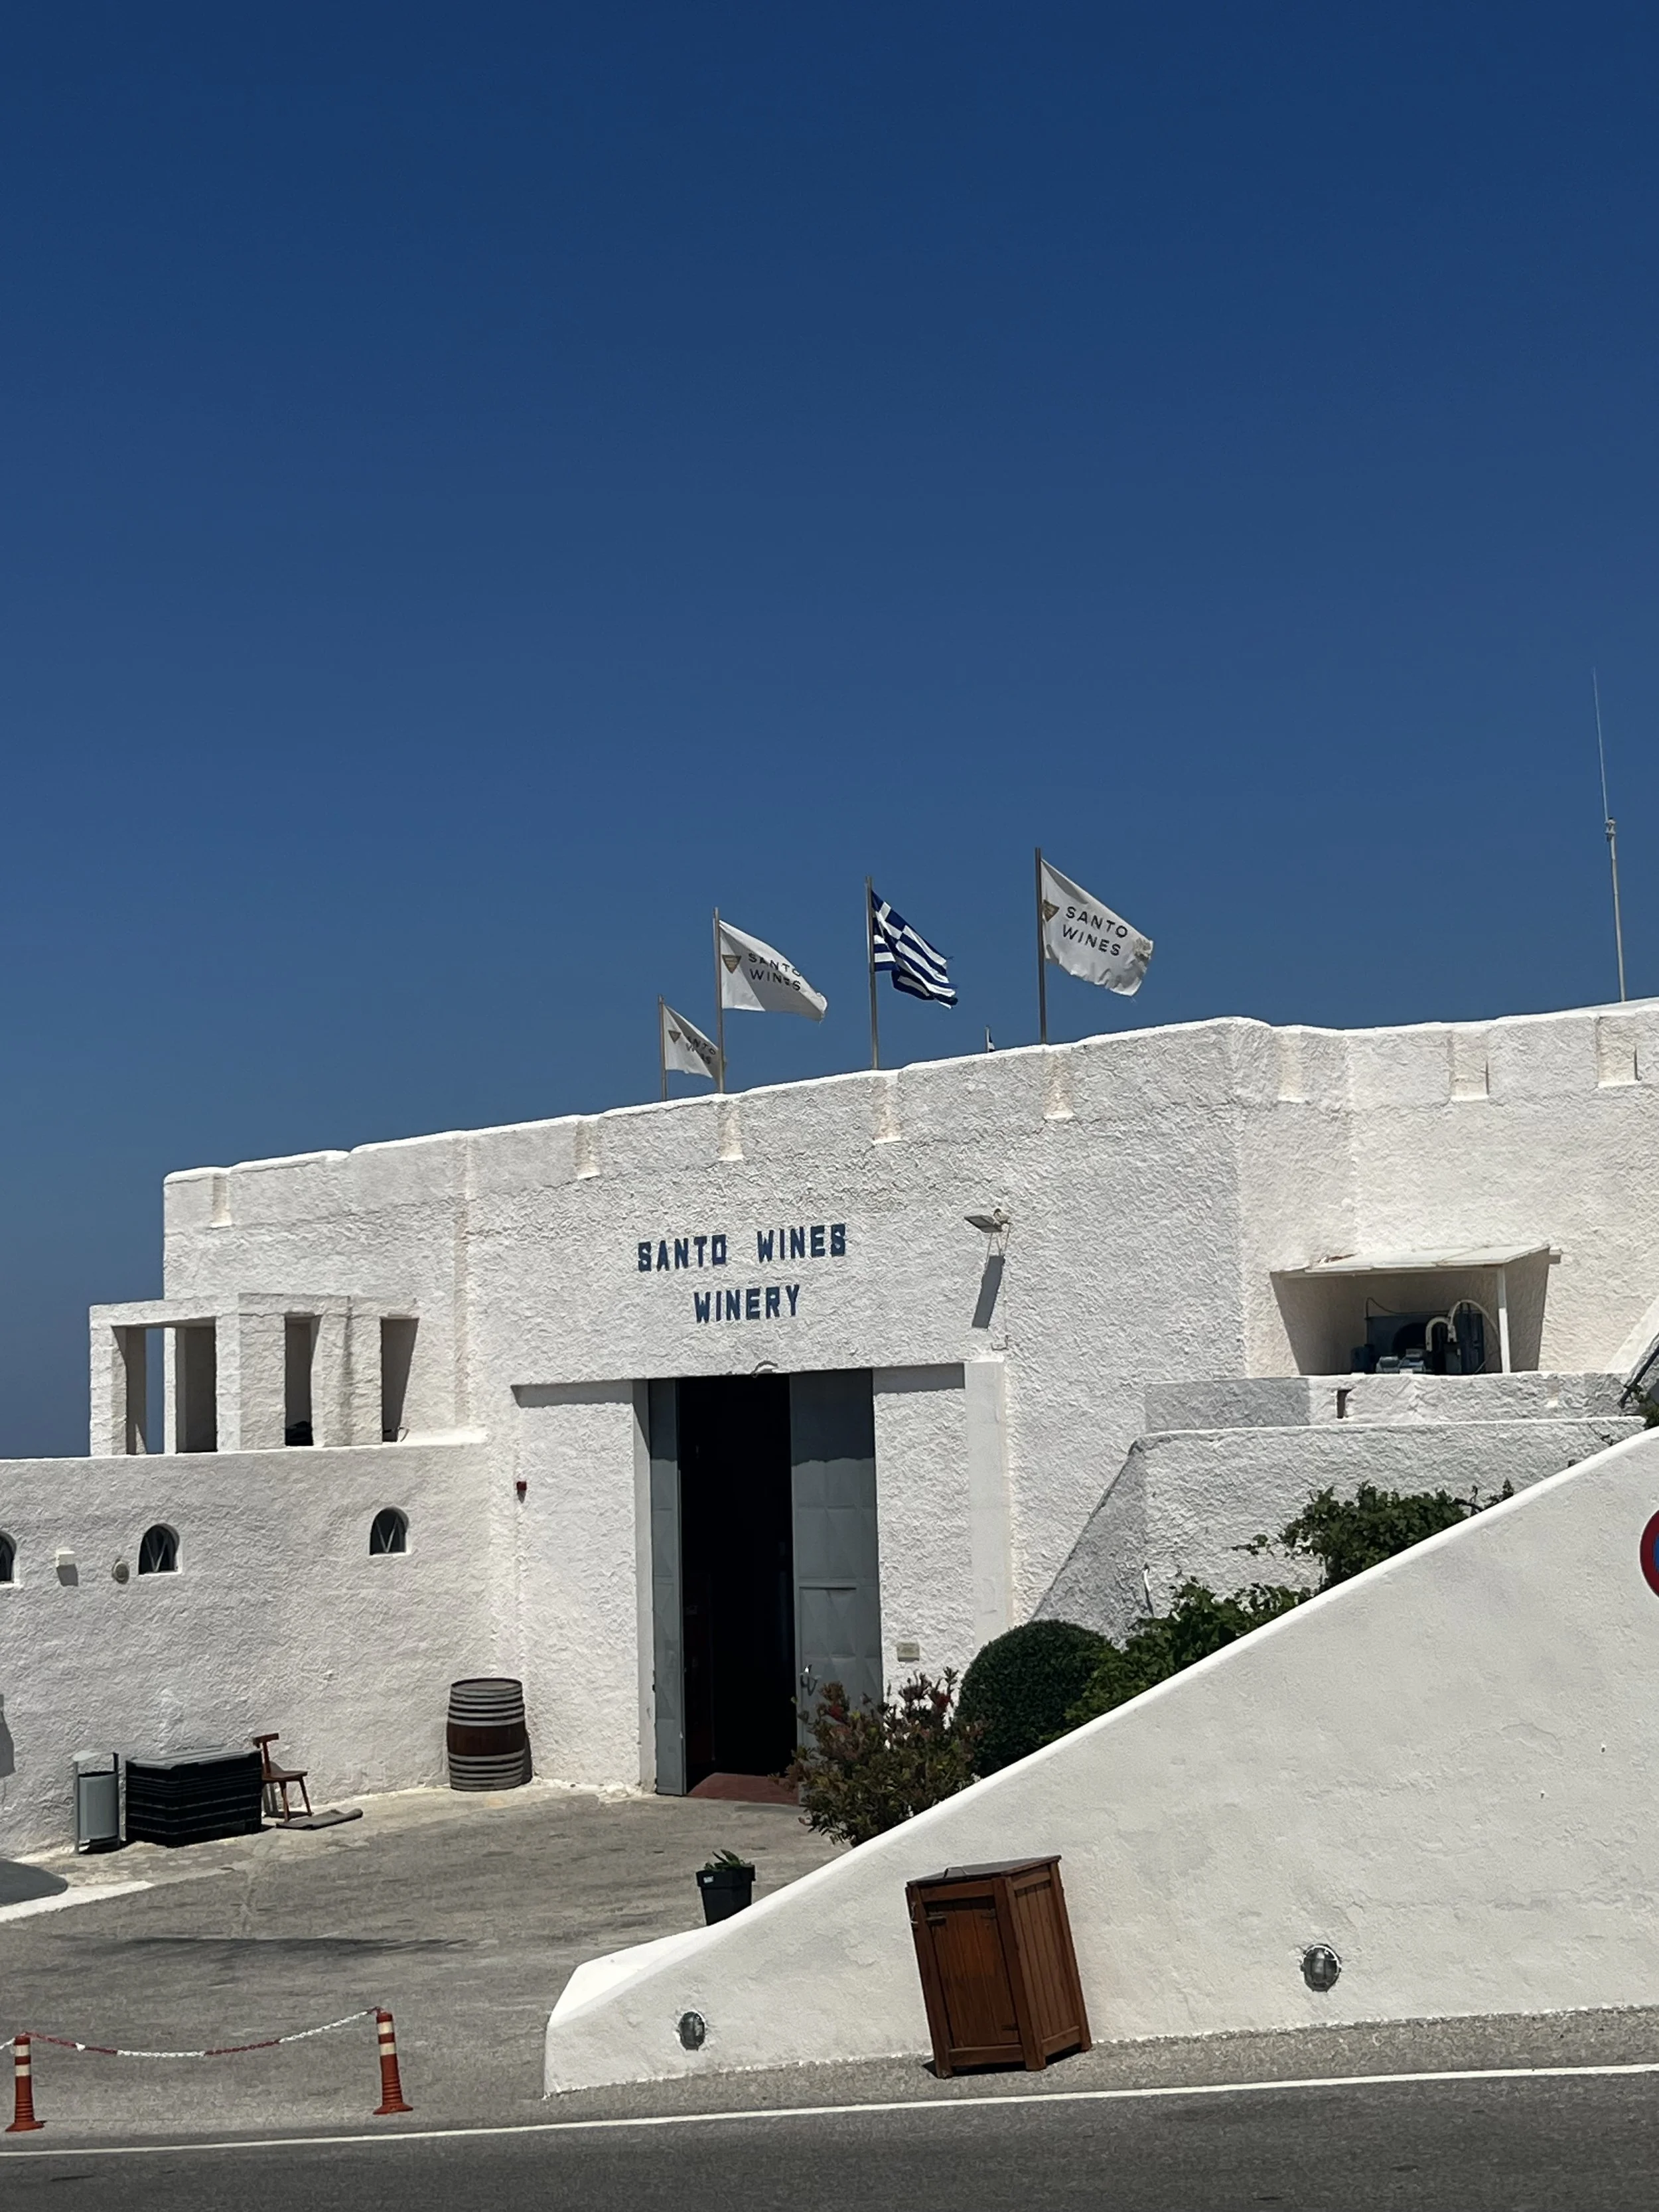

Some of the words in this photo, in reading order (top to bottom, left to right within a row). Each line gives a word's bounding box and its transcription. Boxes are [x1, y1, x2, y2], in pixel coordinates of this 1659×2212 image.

[1066, 906, 1127, 938] SANTO
[1062, 924, 1121, 956] WINES
[748, 952, 802, 977] SANTO
[749, 968, 801, 991] WINES
[638, 1234, 727, 1272] SANTO
[757, 1224, 845, 1263] WINES
[694, 1284, 800, 1323] WINERY
